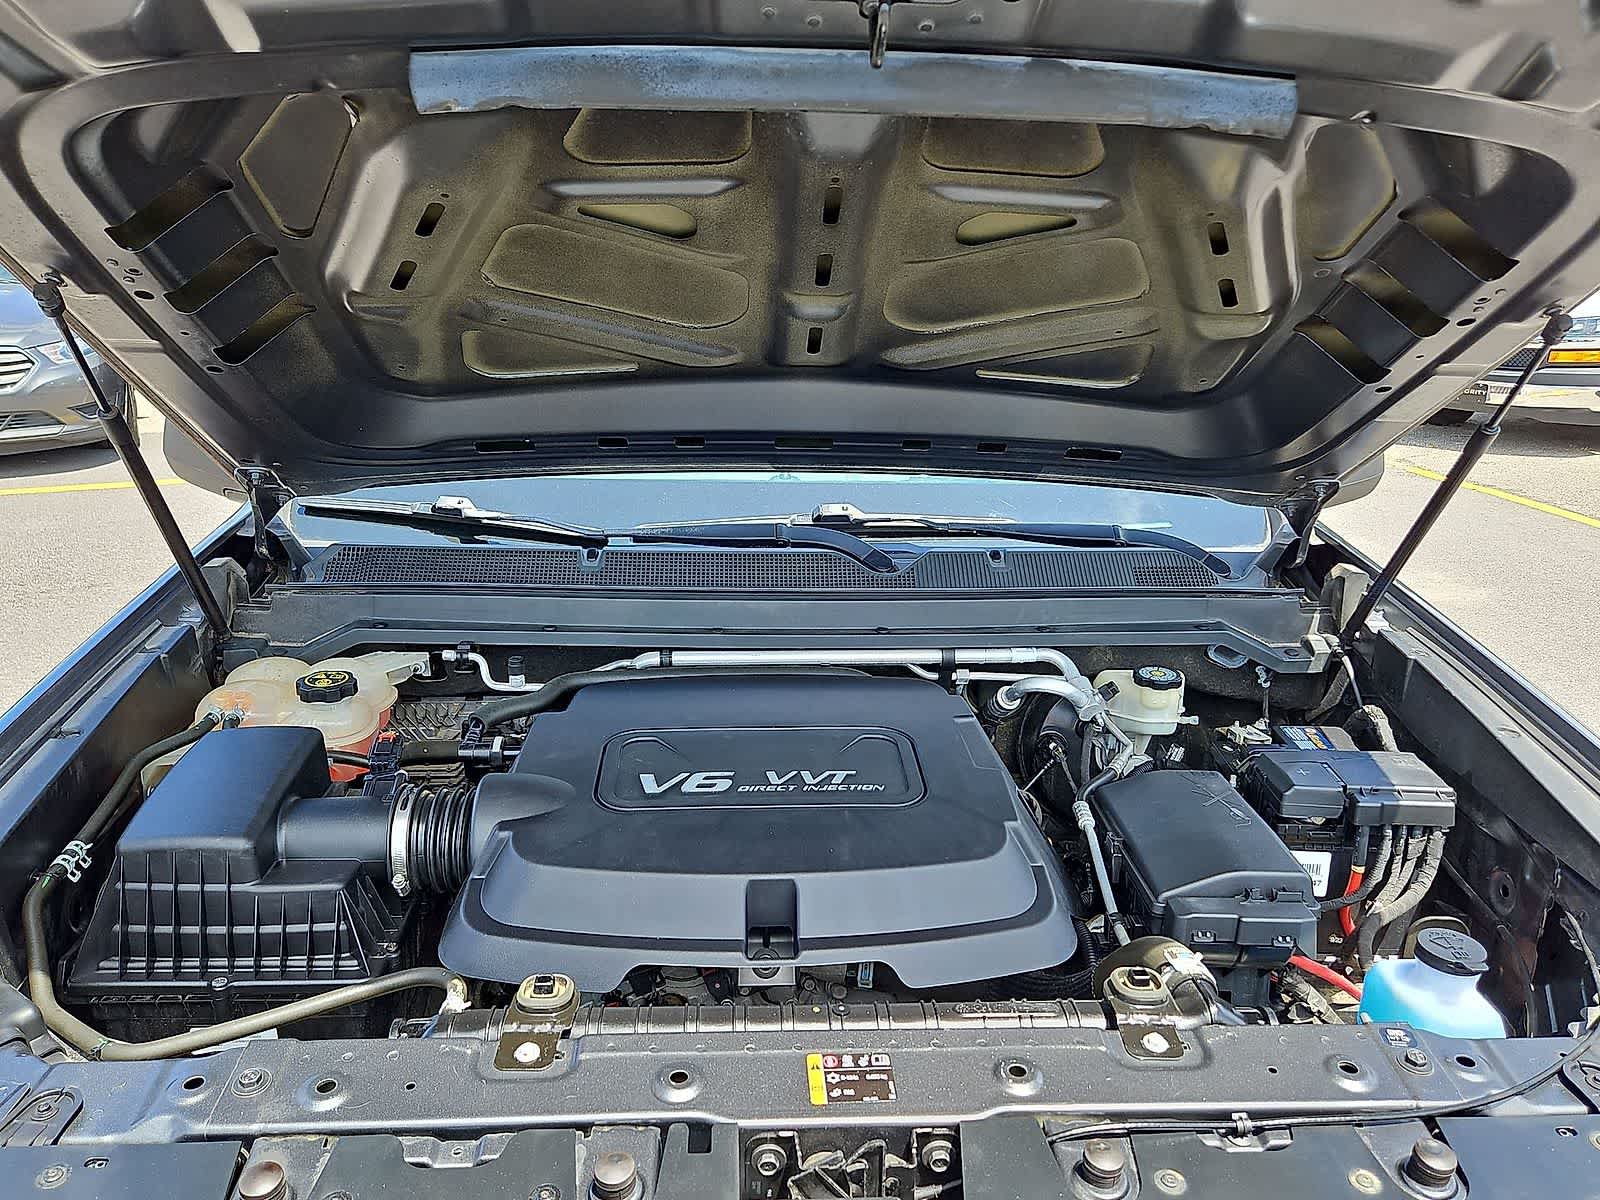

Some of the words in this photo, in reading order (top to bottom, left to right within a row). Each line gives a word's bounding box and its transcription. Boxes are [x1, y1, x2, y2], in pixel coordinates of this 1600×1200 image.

[639, 771, 736, 794] V6
[765, 769, 857, 785] VVT
[737, 784, 798, 793] DIRECT
[802, 783, 885, 792] INJECTION
